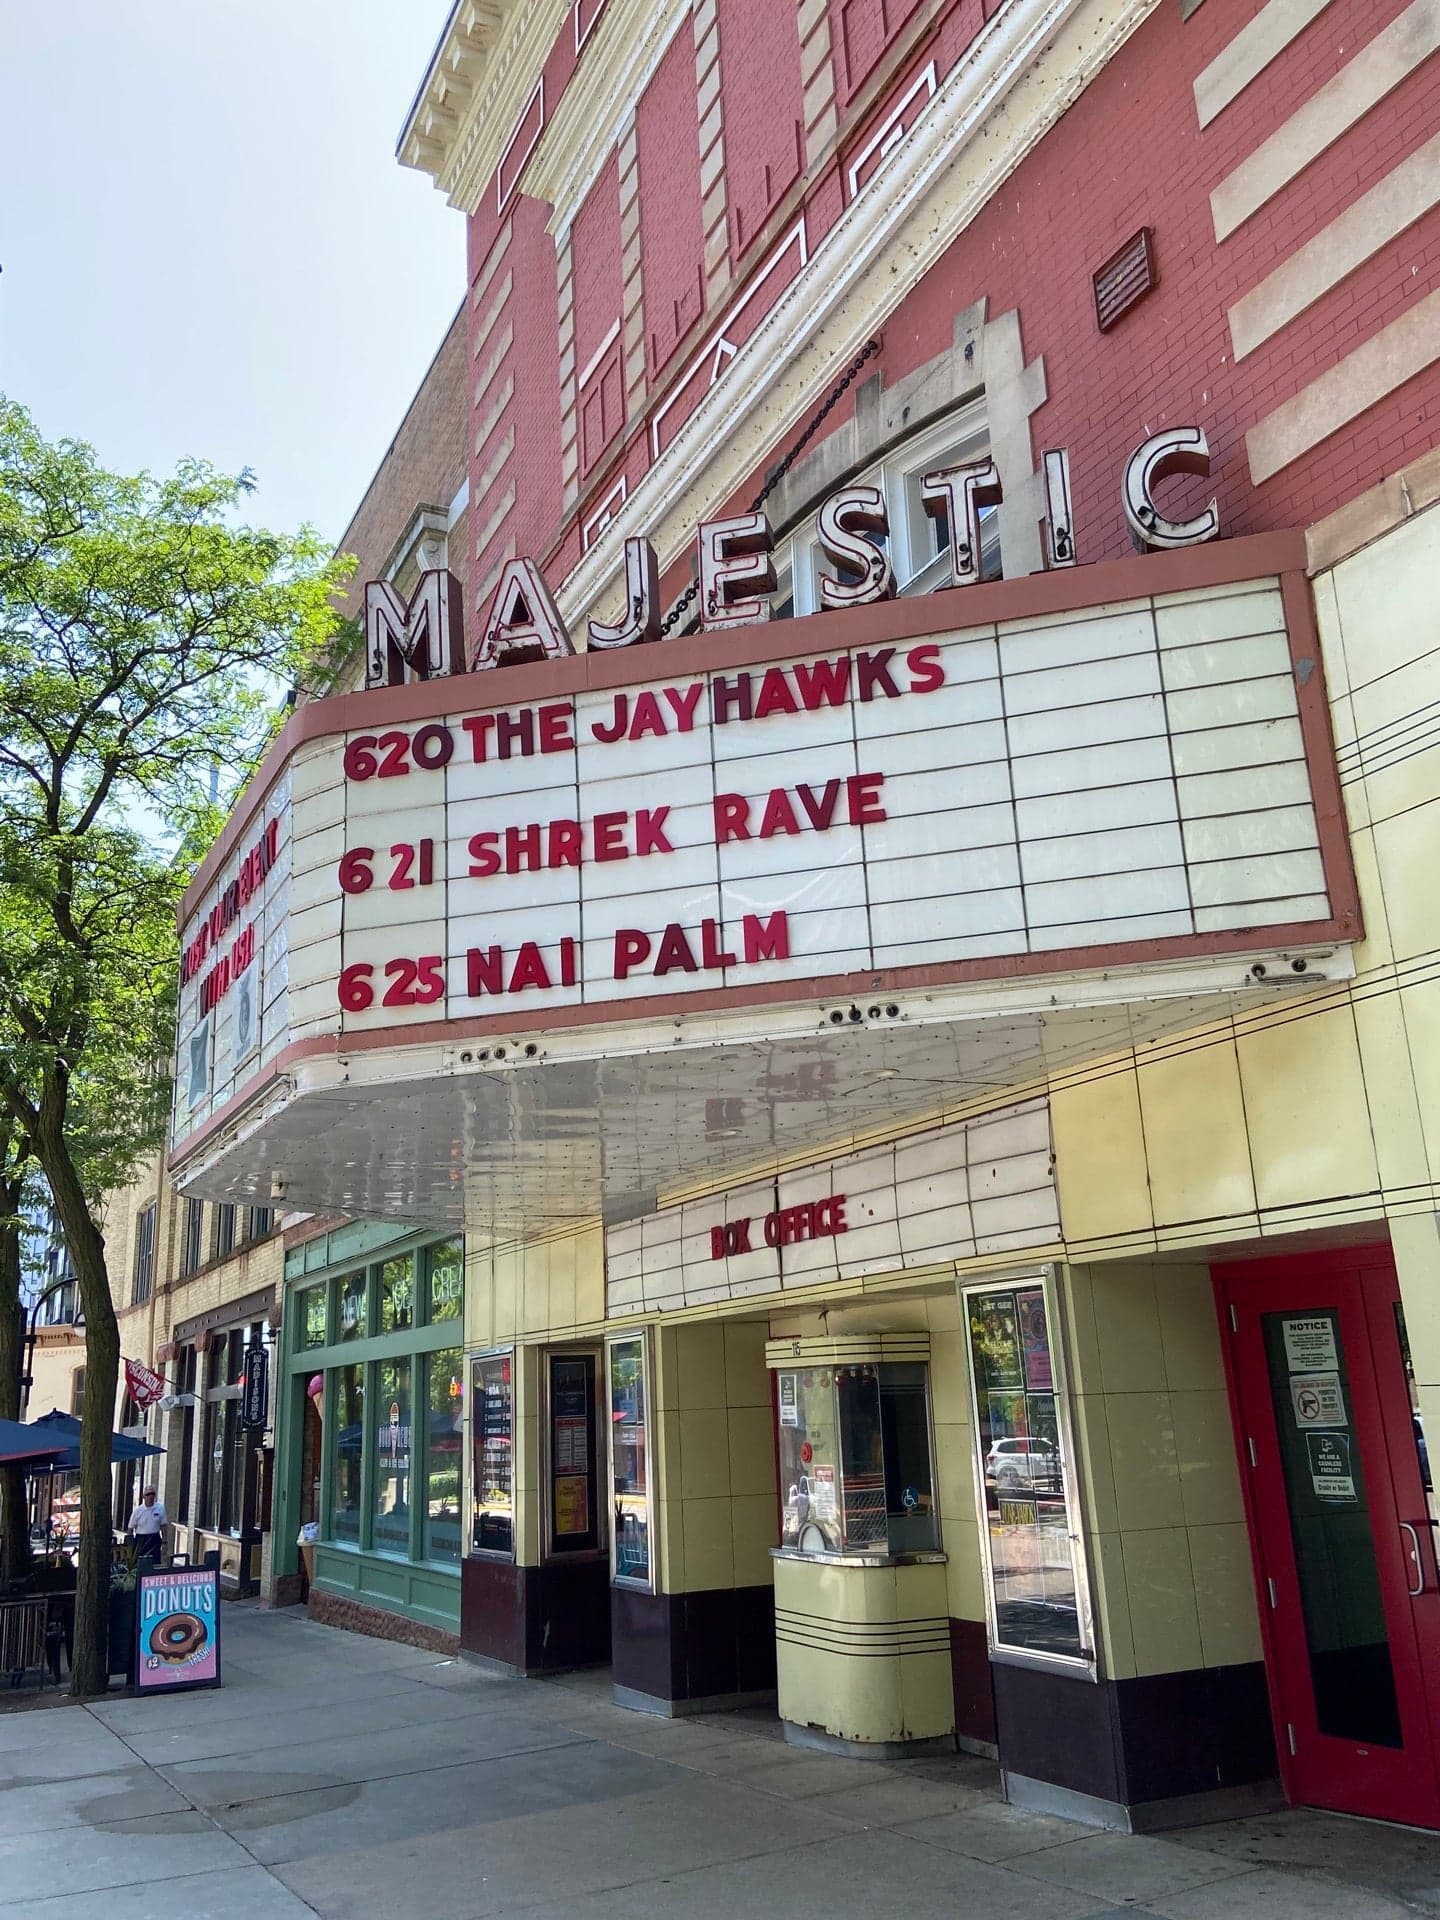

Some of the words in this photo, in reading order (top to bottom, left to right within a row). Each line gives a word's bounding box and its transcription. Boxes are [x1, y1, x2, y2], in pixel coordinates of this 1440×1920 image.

[365, 426, 1220, 690] MAJESTIC
[344, 724, 453, 781] 620
[462, 702, 574, 763] THE
[592, 645, 945, 744] JAYHAWKS
[238, 818, 278, 910] EVENT
[468, 806, 675, 878] SHREK
[713, 772, 887, 845] RAVE
[467, 937, 576, 998] NAI
[613, 910, 790, 980] PALM
[764, 1194, 848, 1248] OFFICE
[1290, 1321, 1328, 1331] NOTICE
[145, 1577, 167, 1587] SWEET
[178, 1573, 213, 1585] DELICIOUS
[145, 1584, 213, 1619] DONUTS
